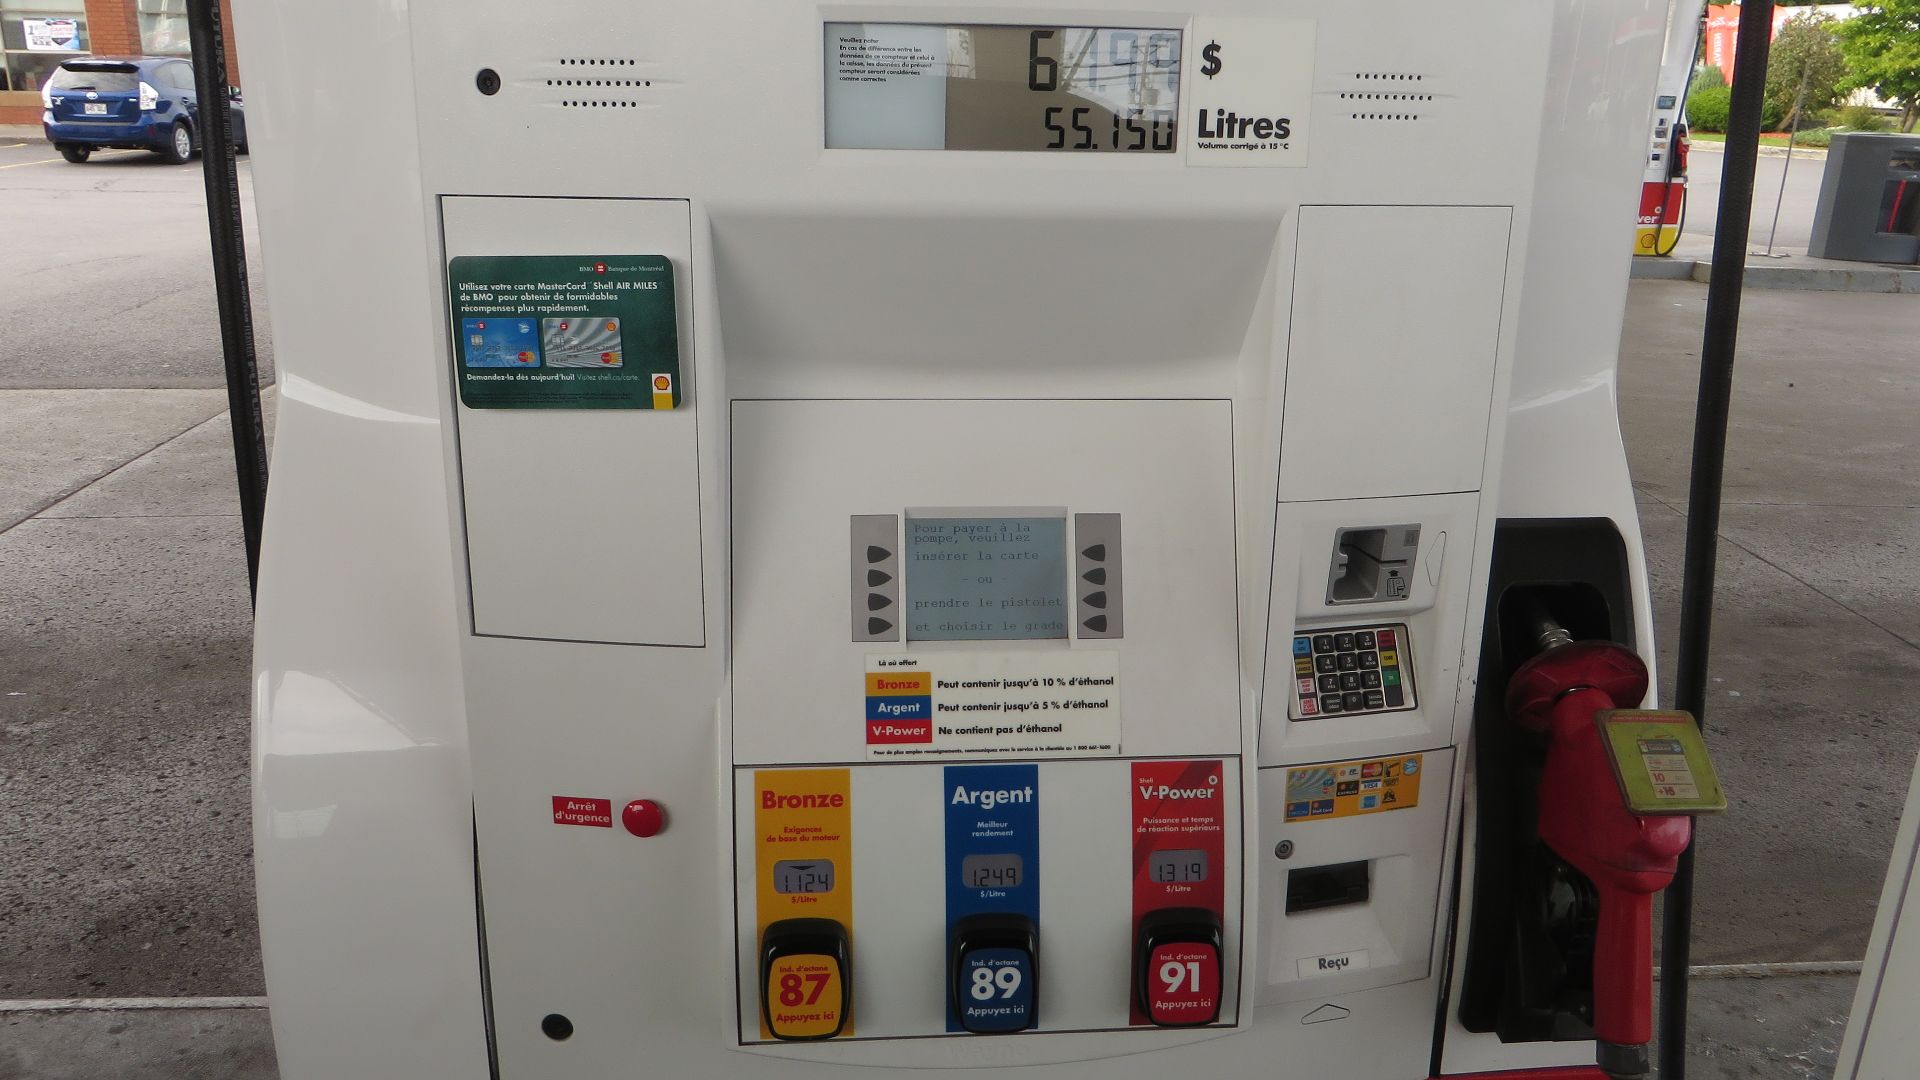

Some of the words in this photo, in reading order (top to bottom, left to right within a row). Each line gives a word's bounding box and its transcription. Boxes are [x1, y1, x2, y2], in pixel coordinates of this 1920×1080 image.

[1200, 40, 1221, 80] $
[1045, 107, 1174, 150] 55.150
[1198, 108, 1290, 139] Litres
[1231, 143, 1258, 151] corrigé
[459, 283, 488, 292] Utilisez
[490, 283, 512, 291] votre
[514, 283, 536, 291] carte
[538, 282, 587, 291] MasterCard
[593, 281, 614, 290] Shell
[617, 282, 631, 290] AIR
[634, 282, 658, 290] MILES
[460, 293, 471, 301] de
[499, 294, 519, 303] pour
[521, 292, 551, 301] obtenir
[554, 292, 565, 301] de
[567, 292, 618, 301] formidables
[461, 304, 515, 314] récompenses
[518, 304, 535, 314] plus
[537, 303, 590, 313] rapidement.
[467, 373, 515, 381] Demandez-la
[517, 373, 530, 381] dès
[531, 373, 576, 382] aujourd'hui!
[577, 373, 597, 381] Visitez
[914, 525, 945, 533] Pour
[953, 526, 992, 536] payer
[1001, 523, 1007, 533] à
[1017, 523, 1031, 533] la
[914, 535, 959, 545] pompe,
[968, 533, 1031, 543] veuillez
[914, 551, 968, 561] insérer
[978, 552, 993, 561] la
[1001, 552, 1039, 561] carte
[914, 599, 970, 609] prendre
[979, 599, 993, 608] le
[1001, 597, 1062, 610] pistolet
[915, 623, 931, 632] et
[939, 622, 993, 632] choisir
[1003, 621, 1017, 631] le
[1025, 621, 1064, 633] grade
[876, 679, 921, 689] Bronze
[938, 680, 959, 689] Peut
[962, 679, 1001, 689] contenir
[1003, 678, 1039, 690] jusqu'à
[1043, 678, 1055, 687] 10
[1057, 678, 1067, 687] %
[1068, 676, 1114, 687] d'éthanol
[878, 703, 921, 716] Argent
[938, 703, 960, 712] Peut
[962, 702, 1002, 712] contenir
[1004, 701, 1040, 713] jusqu'à
[1043, 701, 1049, 710] 5
[1051, 701, 1061, 710] %
[1063, 699, 1109, 711] d'éthanol
[872, 726, 928, 737] V-Power
[938, 727, 953, 735] Ne
[955, 725, 994, 735] contient
[996, 726, 1014, 736] pas
[1016, 723, 1063, 734] d'éthanol
[952, 785, 1033, 810] Argent
[1139, 785, 1215, 800] V-Power
[567, 801, 596, 811] Arrêt
[762, 790, 844, 809] Bronze
[555, 811, 610, 823] d'urgence
[1191, 817, 1214, 825] temps
[784, 826, 822, 835] Exigences
[1148, 825, 1179, 833] réaction
[1181, 824, 1220, 834] supérieurs
[766, 835, 776, 843] de
[974, 868, 1016, 887] 1.249
[1159, 863, 1201, 882] 1.319
[785, 873, 829, 893] 1.124
[791, 896, 818, 904] $/Litre
[1176, 953, 1208, 961] d'octane
[1318, 956, 1349, 971] Reçu
[1159, 961, 1200, 993] 91
[779, 973, 831, 1007] 87
[971, 967, 1022, 1001] 89
[1155, 1000, 1198, 1010] Appuyez
[1200, 998, 1211, 1007] ici
[775, 1013, 821, 1024] Appuyez
[823, 1011, 834, 1021] ici
[967, 1007, 1011, 1017] Appuyez
[1013, 1005, 1025, 1014] ici
